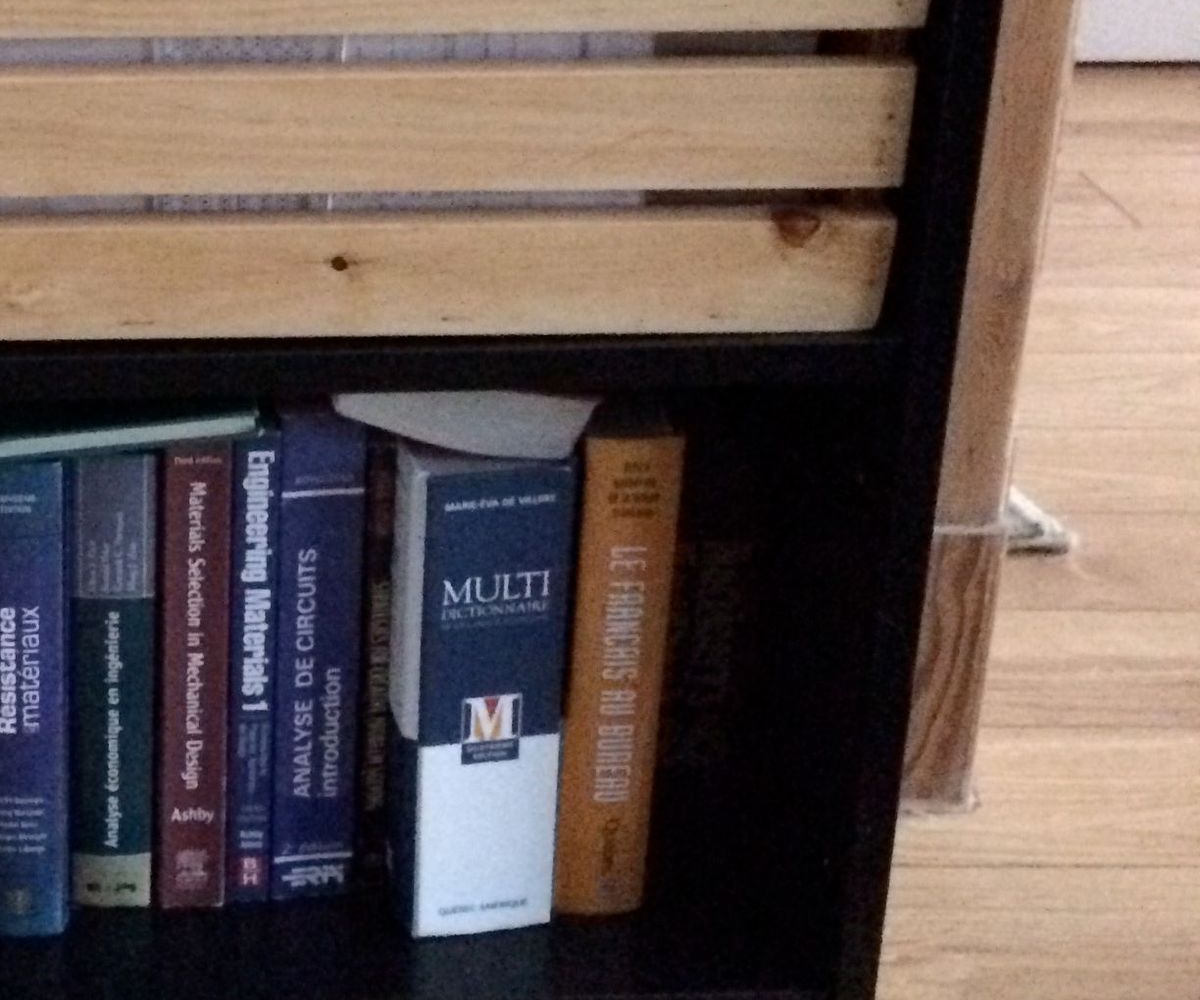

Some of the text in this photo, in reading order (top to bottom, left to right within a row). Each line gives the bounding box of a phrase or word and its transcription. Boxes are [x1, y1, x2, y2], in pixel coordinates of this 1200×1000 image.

[241, 450, 276, 583] Engineering
[441, 570, 550, 606] MULTI
[608, 545, 647, 572] LE
[180, 481, 207, 790] Materials Selection in Mechanical Design
[241, 588, 272, 697] Materials
[441, 600, 549, 621] DICTIONNAIRE
[16, 606, 41, 727] matériaux
[103, 611, 124, 683] ingénierie
[293, 548, 317, 797] ANALYSE DE CIRCUITS
[106, 687, 120, 705] en
[241, 699, 269, 711] 1
[599, 689, 637, 716] AU
[103, 709, 124, 792] économique
[316, 667, 342, 798] introduction
[593, 724, 635, 802] BUREAU
[103, 796, 123, 848] Analyse
[171, 806, 215, 824] Ashby
